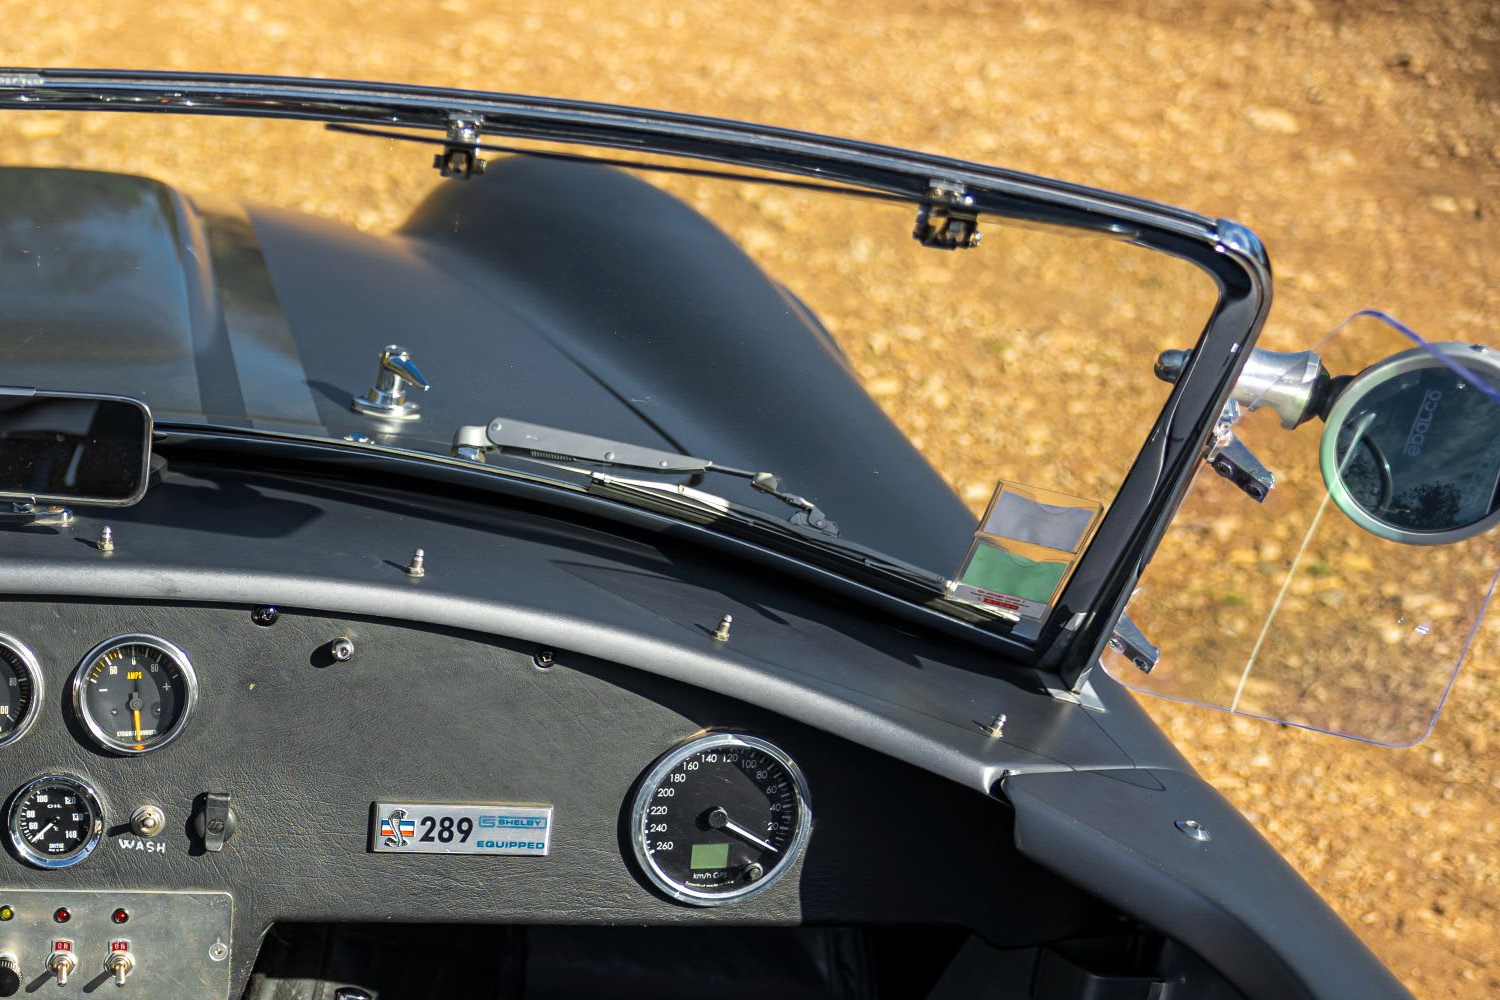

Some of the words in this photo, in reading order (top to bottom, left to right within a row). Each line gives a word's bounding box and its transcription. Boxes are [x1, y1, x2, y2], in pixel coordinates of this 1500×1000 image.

[109, 665, 118, 675] 60
[127, 672, 142, 680] AMPS
[701, 754, 717, 763] 140
[723, 753, 738, 762] 120
[683, 762, 699, 771] 160
[741, 760, 756, 769] 100
[670, 773, 686, 783] 180
[756, 771, 767, 780] 80
[657, 788, 675, 797] 200
[766, 786, 777, 794] 60
[36, 794, 48, 803] 100
[64, 796, 76, 805] 120
[650, 806, 668, 815] 220
[770, 803, 781, 812] 40
[26, 810, 36, 819] 80
[28, 821, 38, 830] 60
[498, 818, 542, 827] SHELBY
[767, 822, 779, 831] 20
[418, 816, 474, 844] 289
[650, 823, 667, 833] 240
[65, 830, 77, 839] 140
[118, 838, 166, 854] WASH
[476, 840, 545, 850] EQUIPPED
[656, 841, 673, 850] 260
[57, 942, 69, 950] ON
[114, 942, 127, 950] ON
